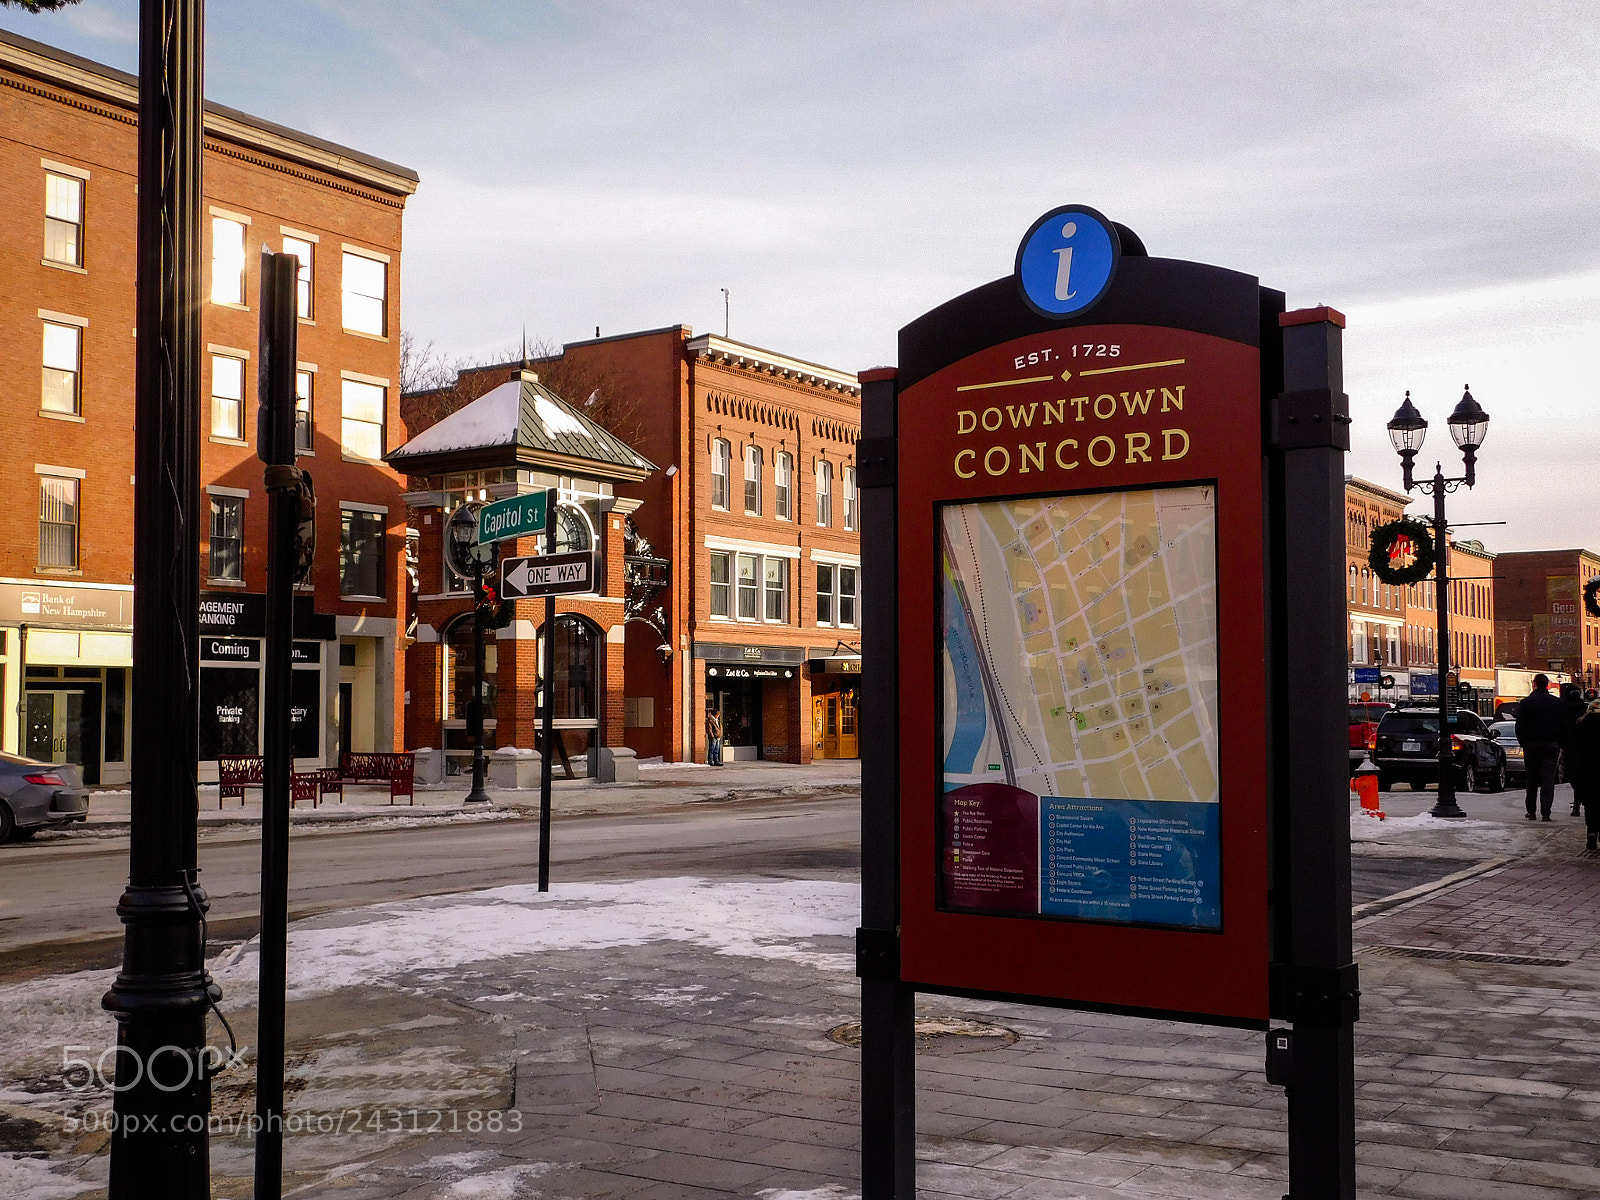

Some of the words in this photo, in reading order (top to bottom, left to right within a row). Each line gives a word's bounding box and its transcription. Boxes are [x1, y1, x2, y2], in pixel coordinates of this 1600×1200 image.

[1014, 348, 1060, 370] EST.
[1072, 344, 1121, 357] 1725
[957, 385, 1186, 435] DOWNTOWN
[954, 428, 1190, 479] CONCORD
[484, 505, 522, 535] Capitol
[527, 508, 538, 523] St
[527, 568, 550, 584] ONE
[558, 564, 582, 581] WAY
[42, 594, 64, 604] Bank
[66, 596, 75, 604] of
[199, 602, 244, 613] AGEMENT
[42, 605, 60, 615] New
[63, 606, 106, 618] Hampshire
[212, 642, 249, 658] Coming
[216, 706, 243, 715] Private
